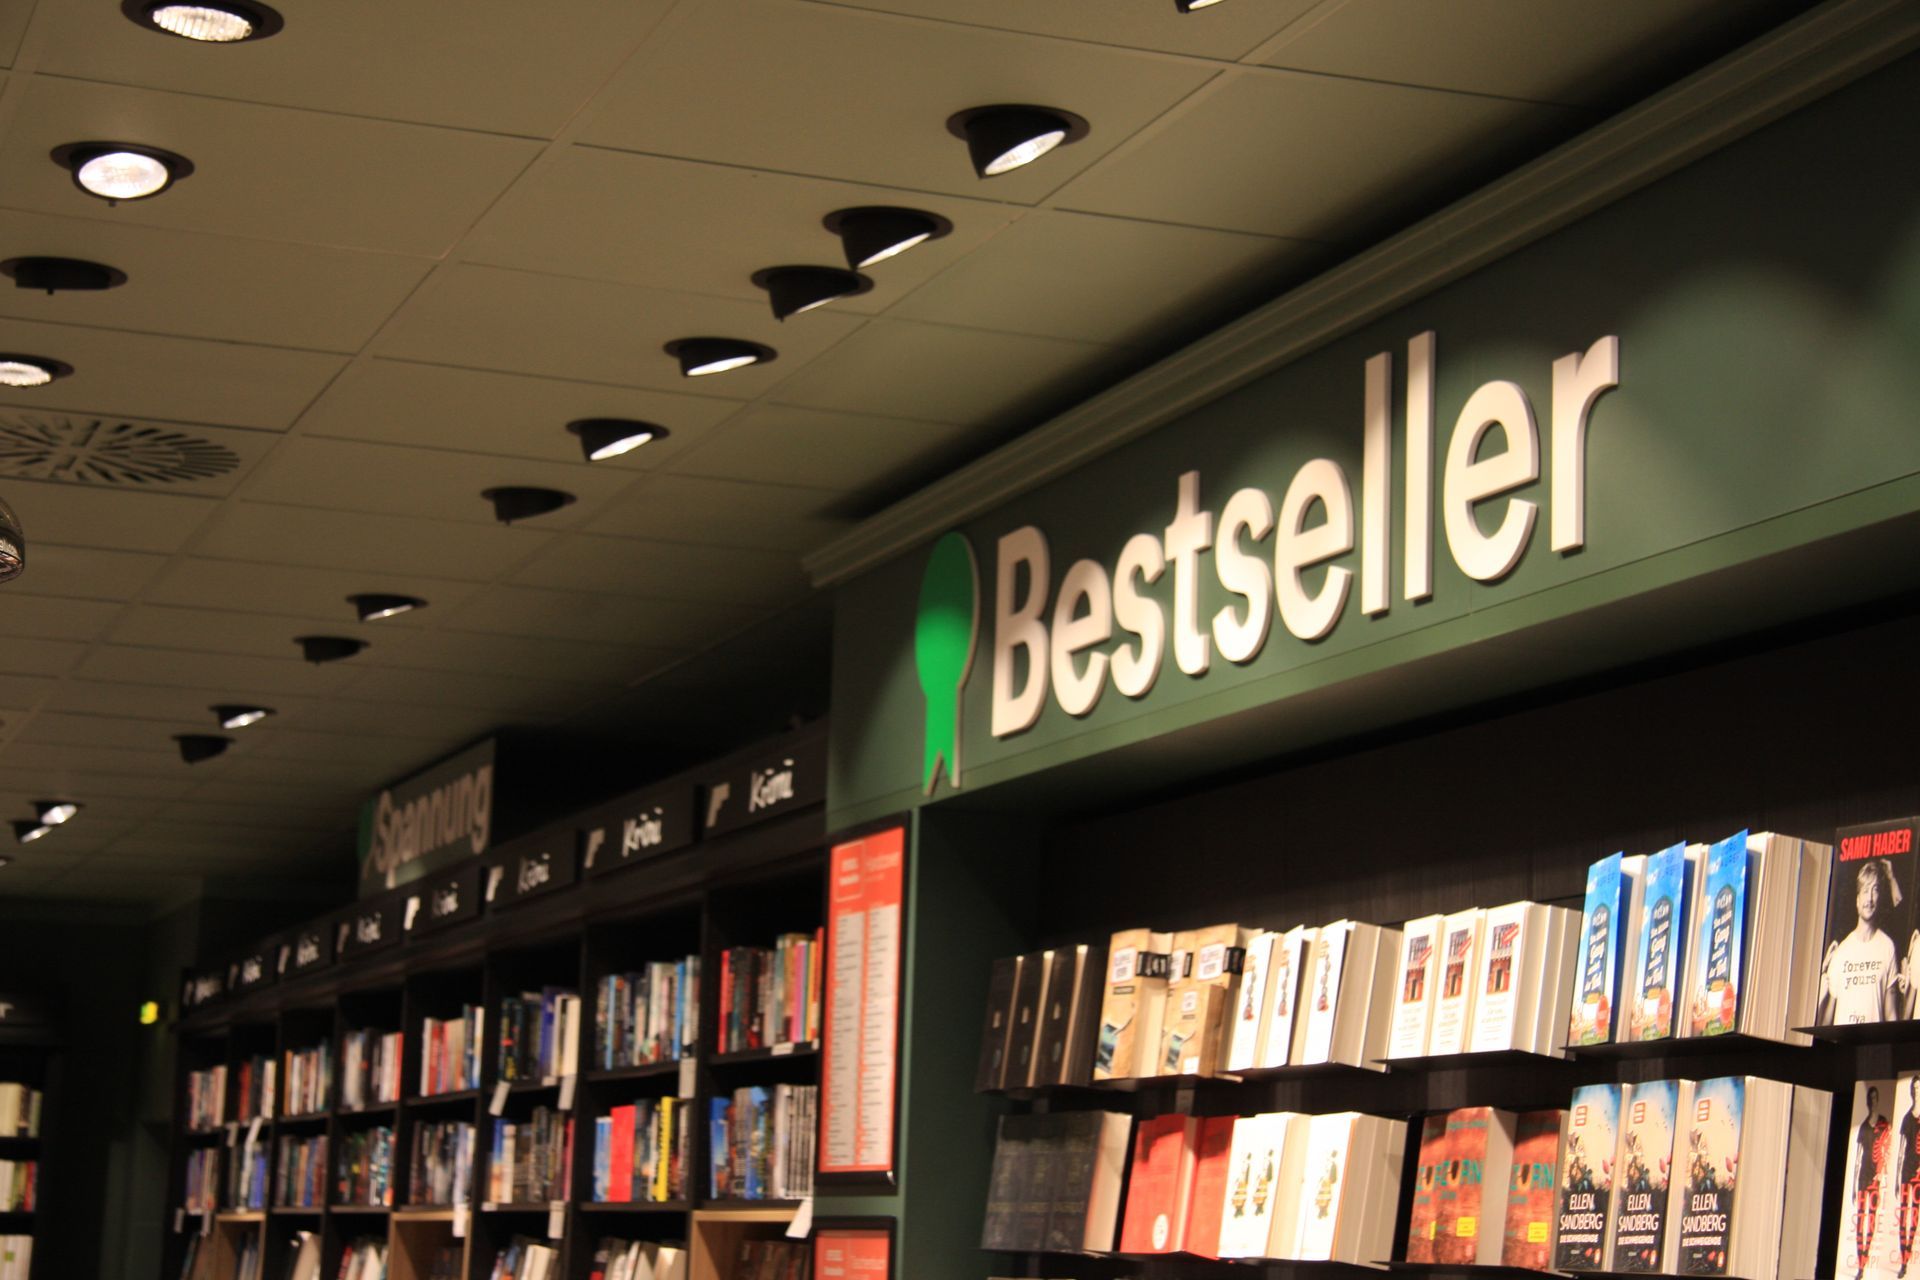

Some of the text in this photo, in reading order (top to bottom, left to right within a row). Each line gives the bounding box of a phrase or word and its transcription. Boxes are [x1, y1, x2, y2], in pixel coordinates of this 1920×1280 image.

[991, 330, 1619, 738] Bestseller
[749, 758, 794, 813] Krimi
[374, 765, 493, 889] Spannung
[1839, 829, 1912, 861] SAMU HABER
[1842, 959, 1882, 974] forever
[1845, 974, 1877, 990] yours
[1569, 1193, 1595, 1211] ELLEN
[1627, 1193, 1652, 1212] ELLEN
[1691, 1193, 1718, 1212] ELLEN
[1560, 1213, 1603, 1231] SANDBERG
[1618, 1213, 1660, 1233] SANDBERG
[1682, 1214, 1727, 1234] SANDBERG
